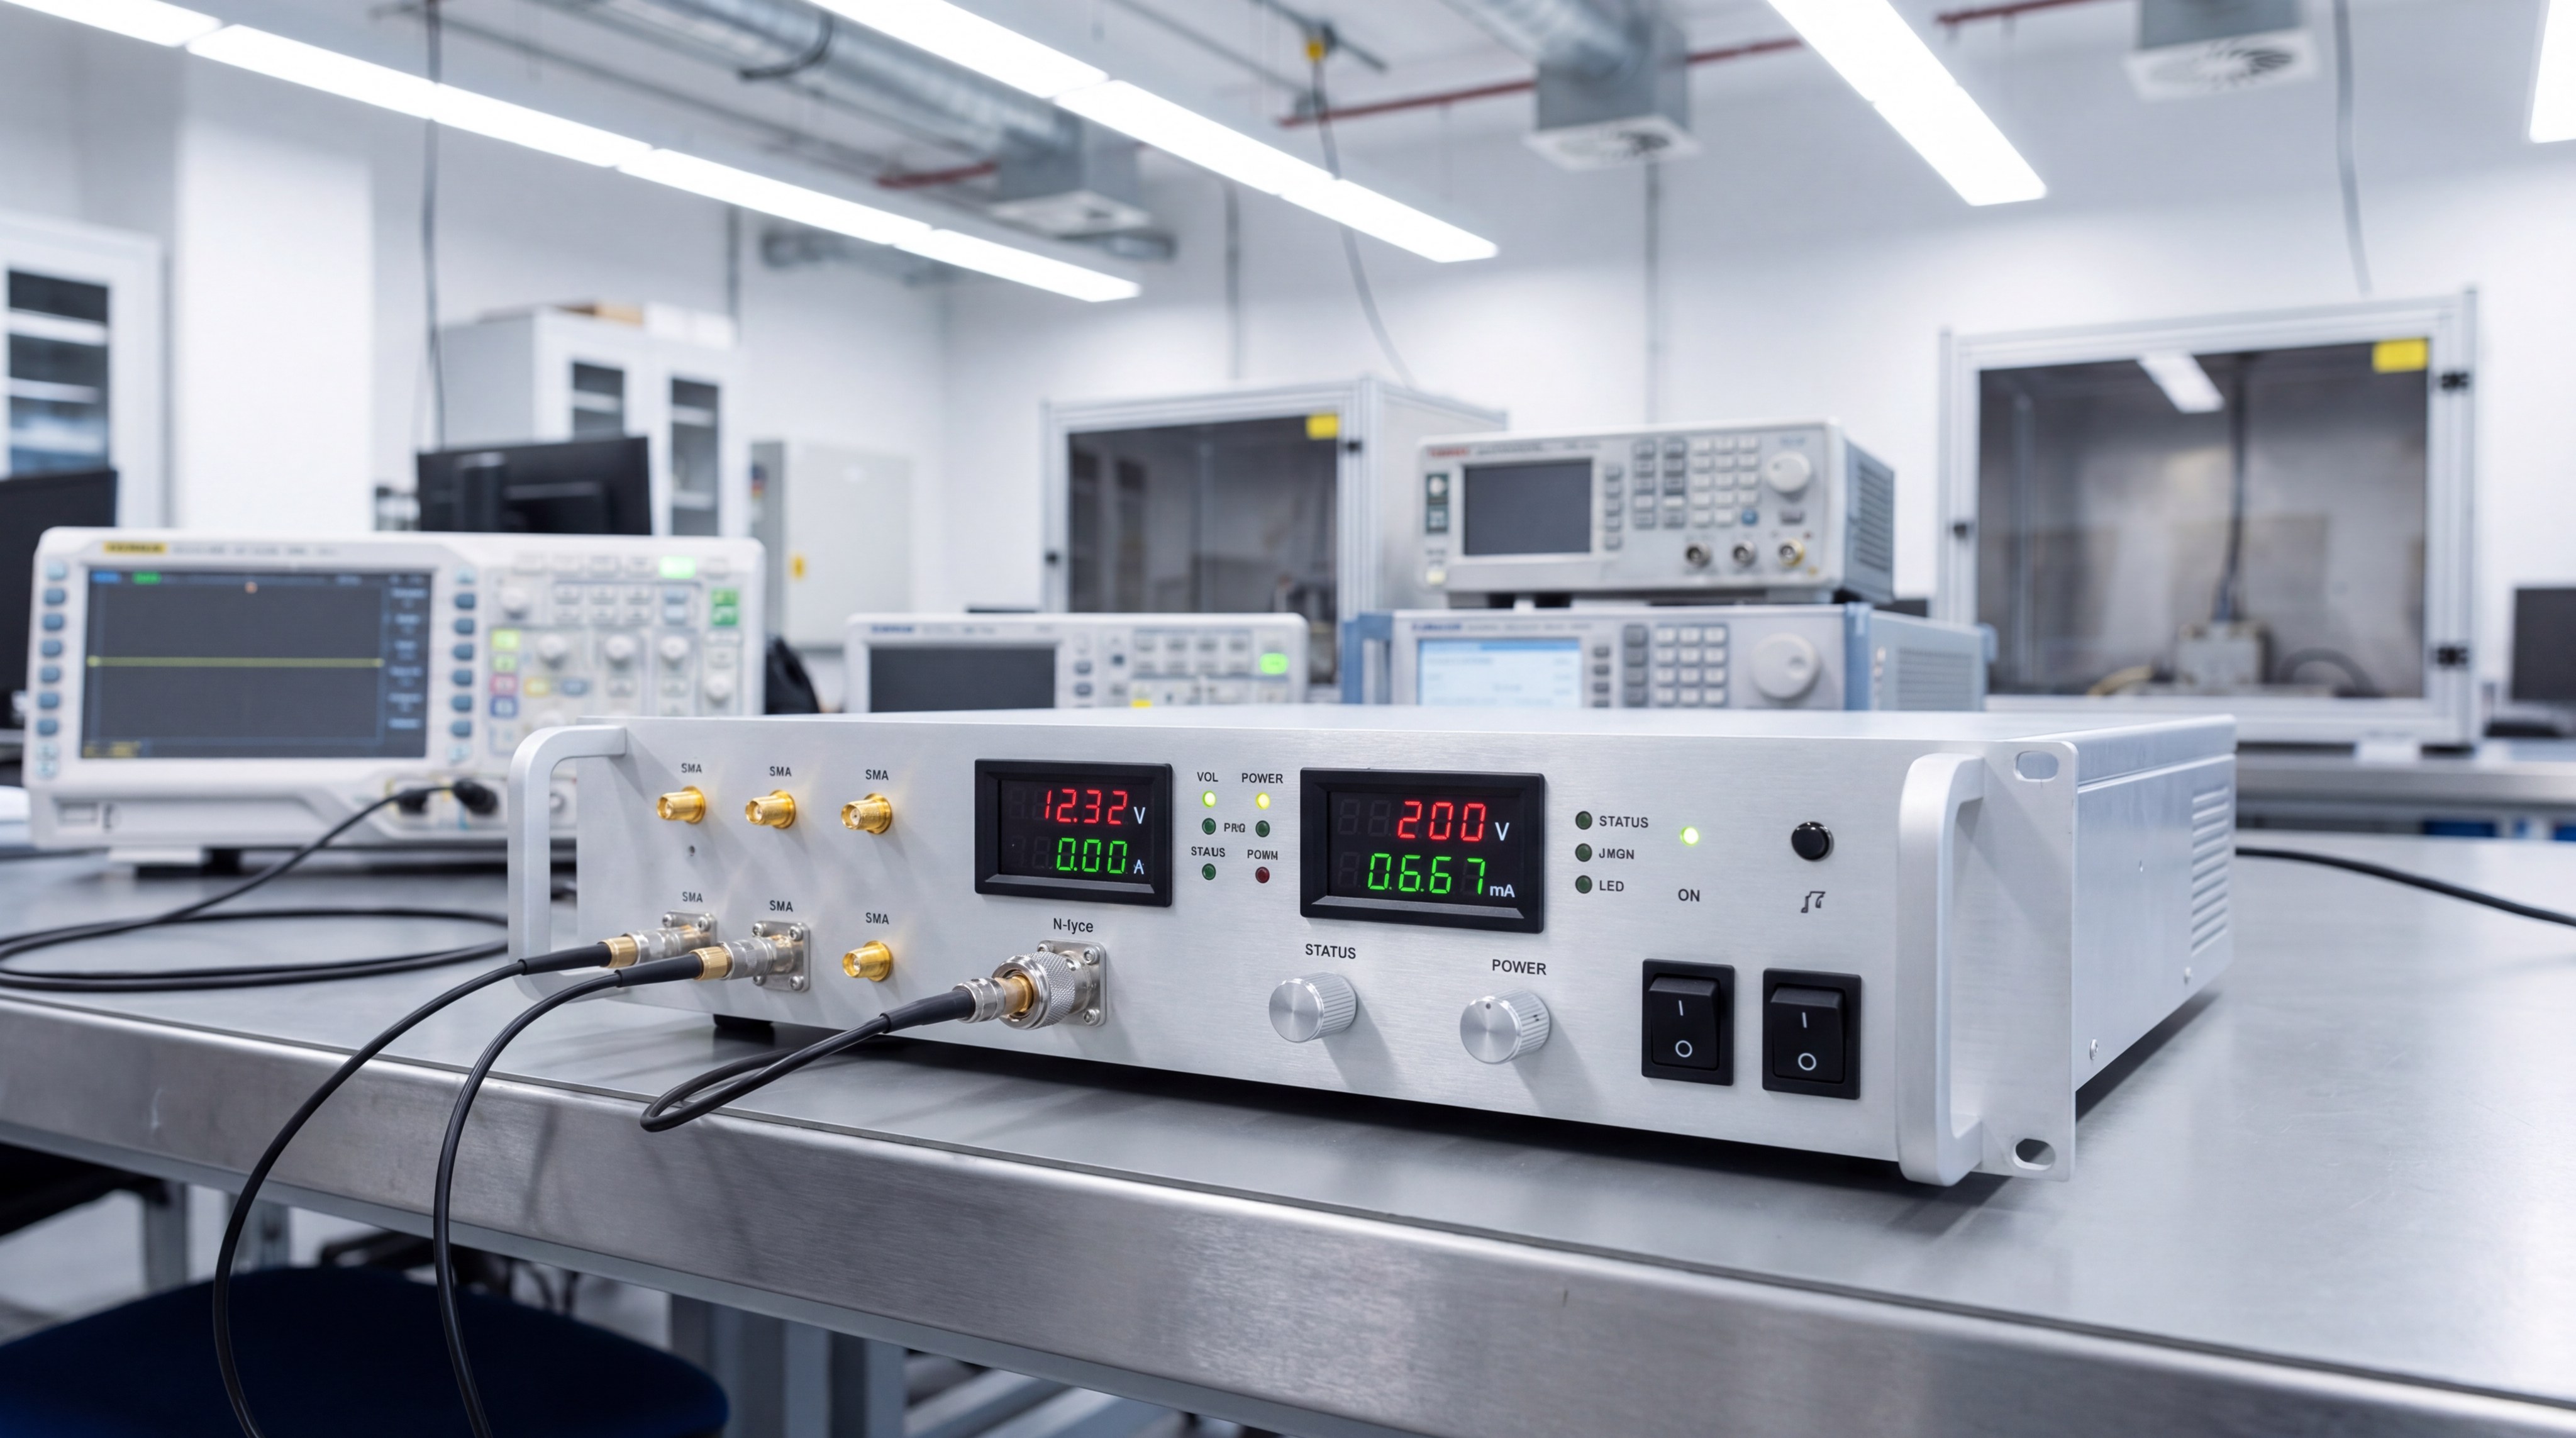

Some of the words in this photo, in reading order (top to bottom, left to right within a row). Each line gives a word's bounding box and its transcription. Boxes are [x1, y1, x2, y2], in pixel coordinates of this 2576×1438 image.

[680, 762, 702, 774] SMA
[769, 766, 792, 777] SMA
[865, 769, 889, 781] SMA
[1197, 771, 1219, 783] VOL
[1241, 772, 1284, 784] POWER
[1045, 788, 1128, 825] 12.32
[1133, 806, 1146, 825] V
[1397, 801, 1486, 842] 200
[1494, 822, 1510, 841] V
[1599, 815, 1649, 828] STATUS
[1056, 837, 1128, 874] 0.00
[1133, 859, 1145, 875] A
[1598, 848, 1635, 860] JMGN
[1489, 884, 1515, 898] mA
[1599, 880, 1624, 892] LED
[682, 891, 703, 903] SMA
[1678, 888, 1700, 902] ON
[769, 900, 794, 912] SMA
[865, 911, 889, 925] SMA
[1305, 943, 1356, 959] STATUS
[1492, 959, 1546, 976] POWER
